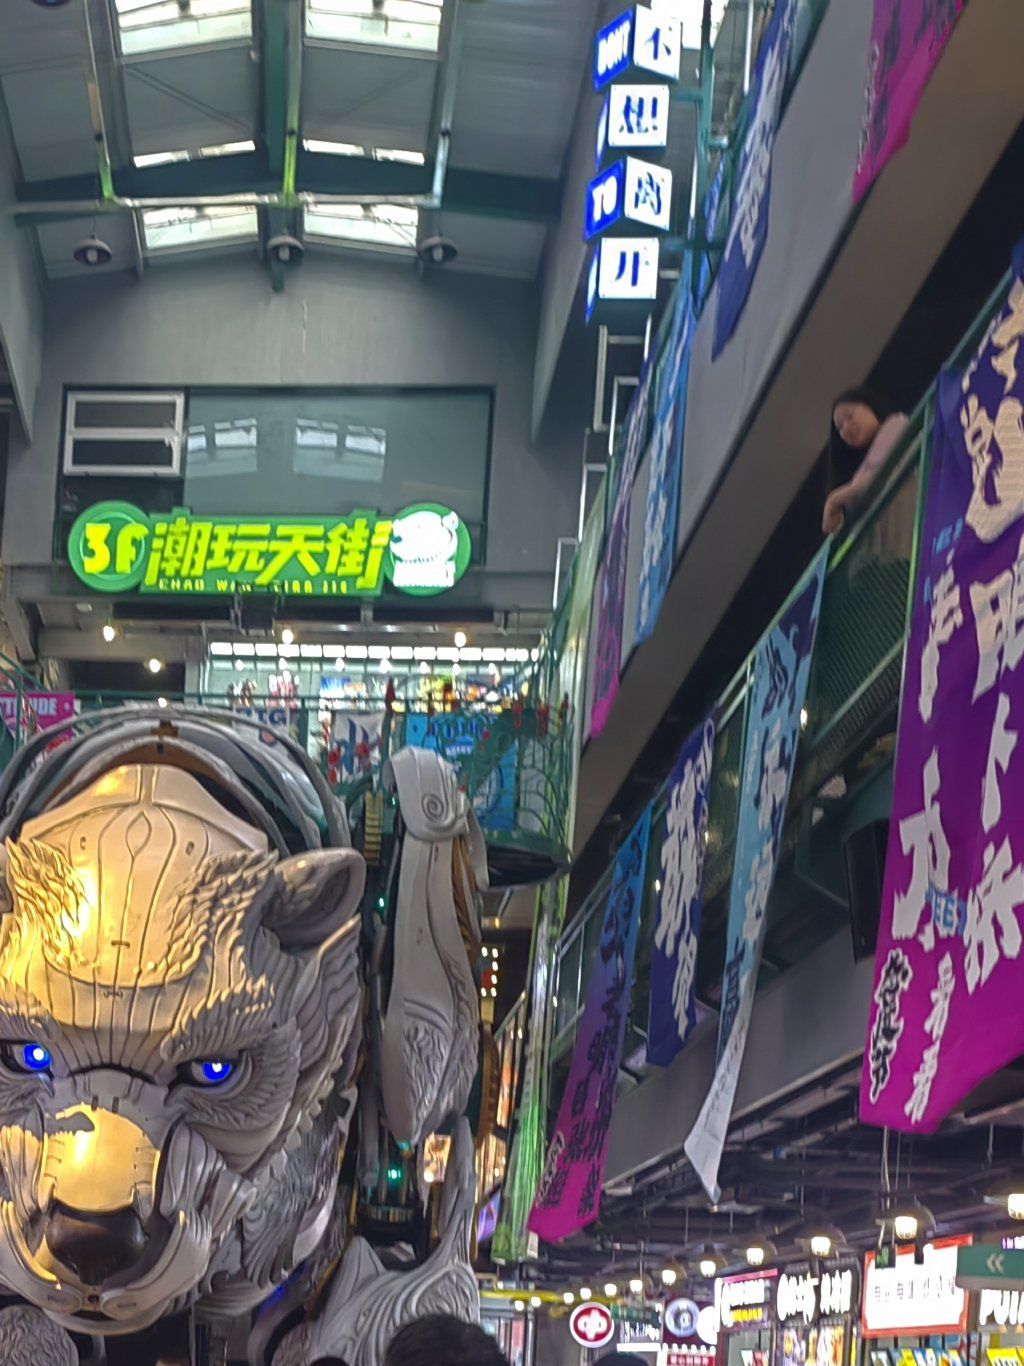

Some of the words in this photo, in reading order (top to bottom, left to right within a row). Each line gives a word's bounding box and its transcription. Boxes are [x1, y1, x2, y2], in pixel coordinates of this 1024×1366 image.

[592, 175, 618, 223] TO
[83, 523, 150, 575] 3F
[144, 517, 394, 590] 潮玩天街
